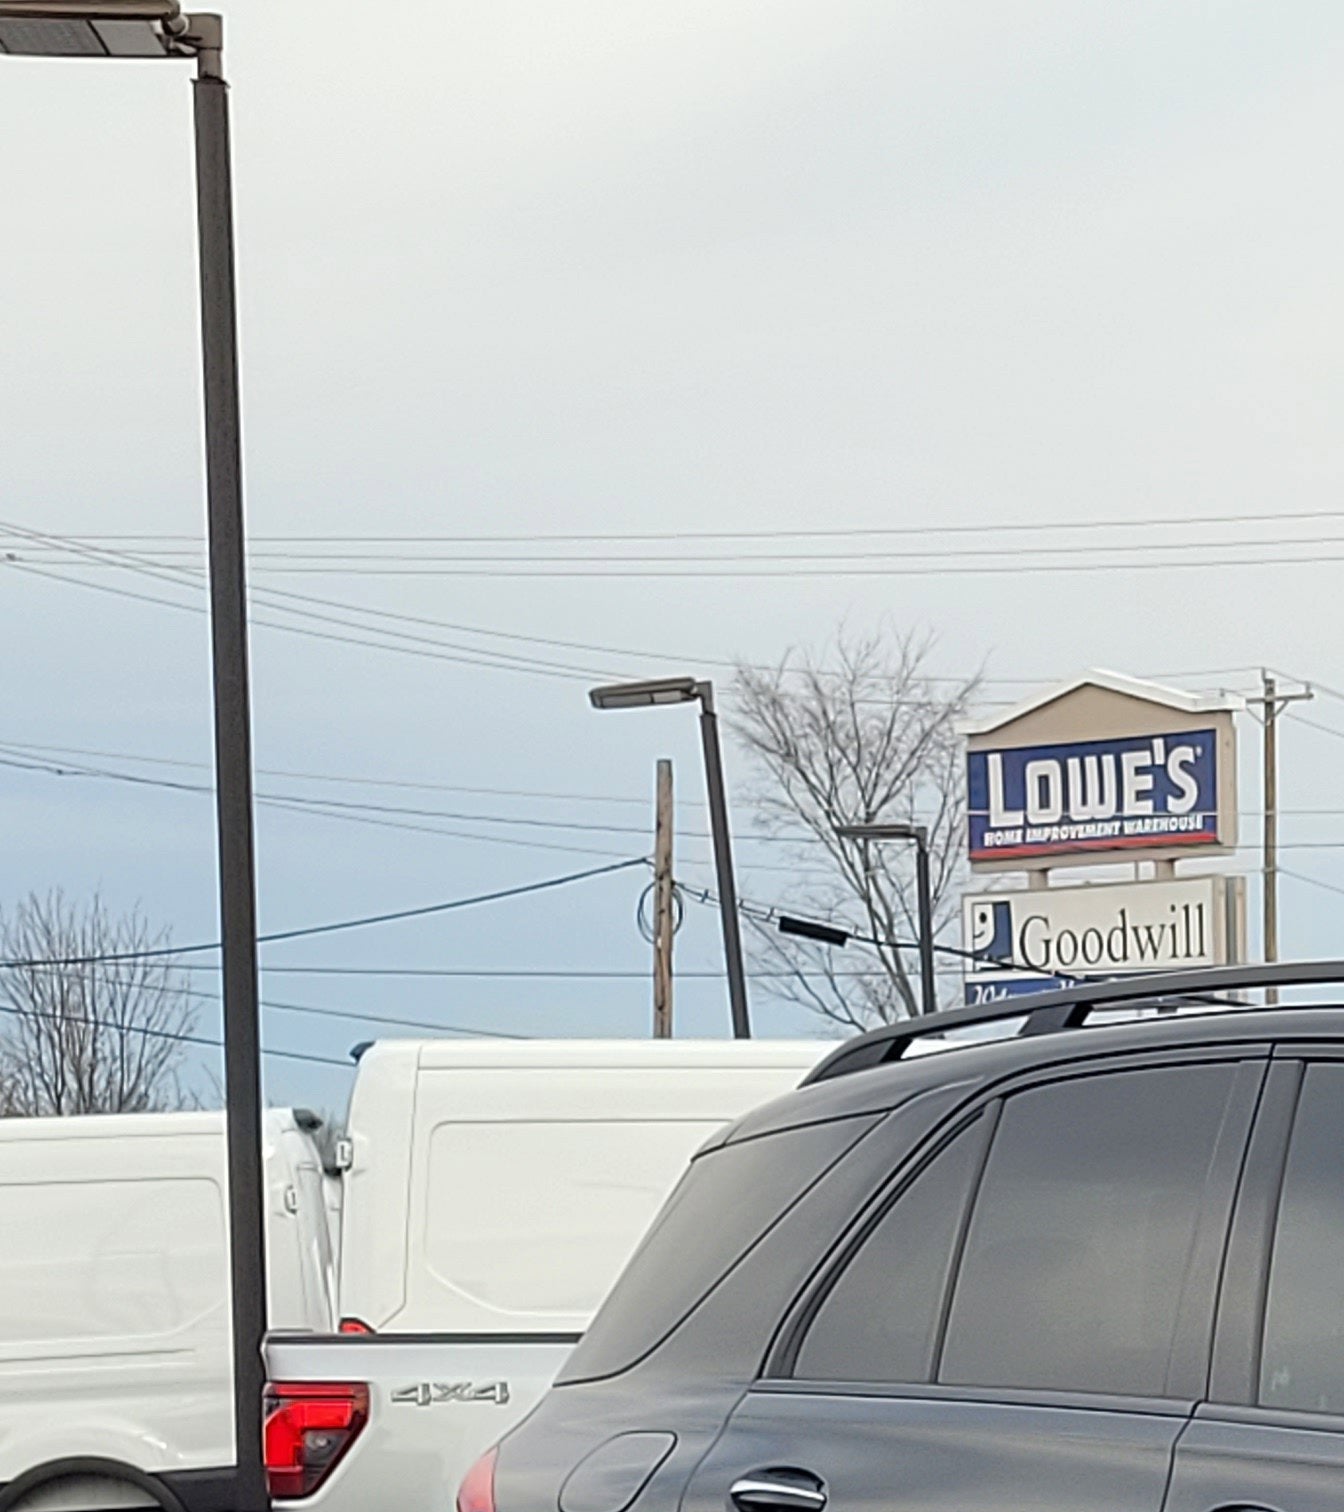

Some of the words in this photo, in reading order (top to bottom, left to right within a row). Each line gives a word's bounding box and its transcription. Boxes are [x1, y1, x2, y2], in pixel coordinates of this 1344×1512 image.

[987, 738, 1199, 827] LOWE'S
[984, 829, 1023, 846] HOME
[1026, 821, 1121, 842] IMPROVEMENT
[1124, 814, 1204, 835] WAREHOUSE
[1020, 903, 1205, 968] Goodwill
